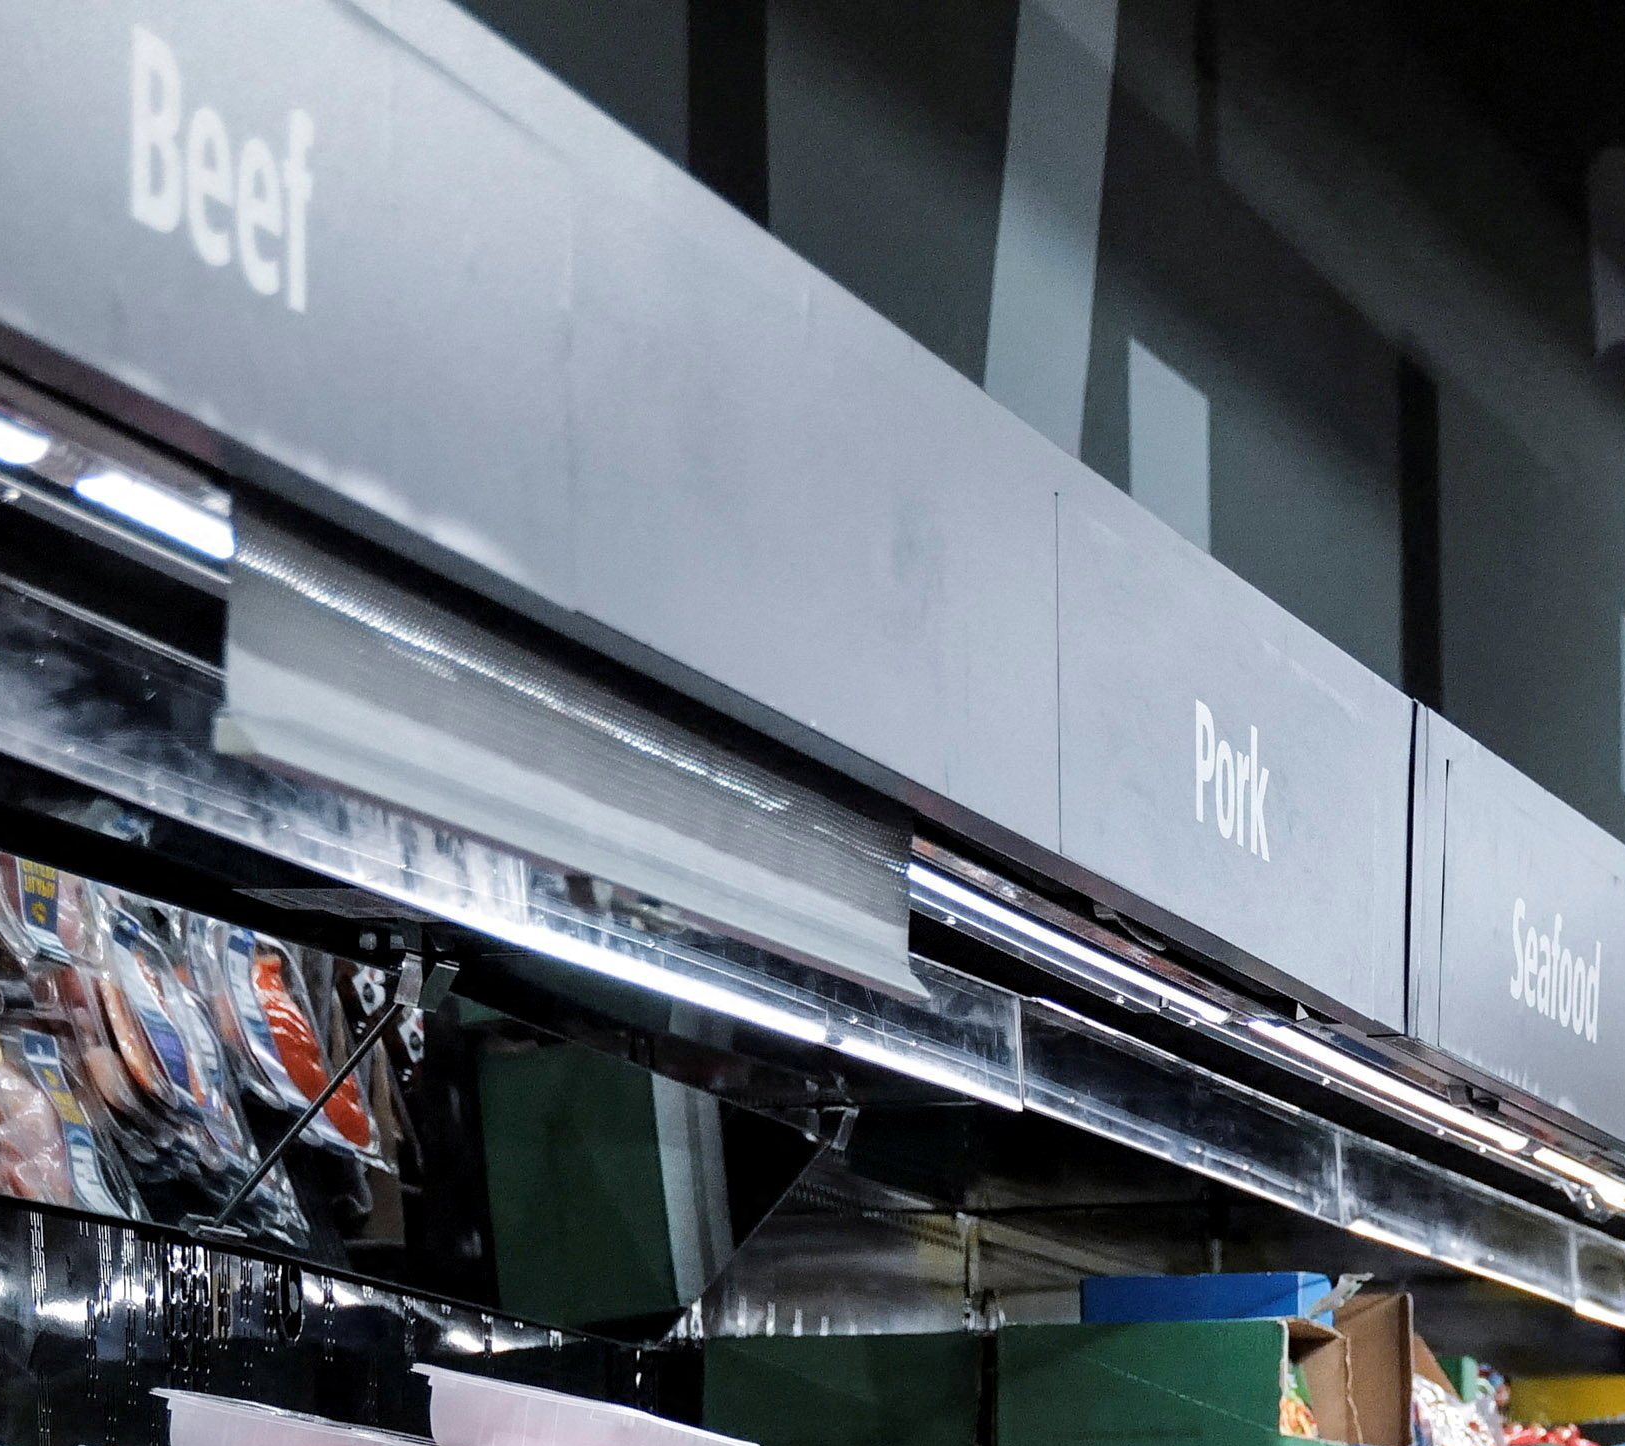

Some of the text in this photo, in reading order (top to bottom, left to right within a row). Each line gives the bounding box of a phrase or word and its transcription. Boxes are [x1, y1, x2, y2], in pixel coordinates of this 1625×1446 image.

[130, 23, 314, 313] Beef
[1194, 700, 1271, 864] Pork
[1511, 899, 1601, 1045] Seafood
